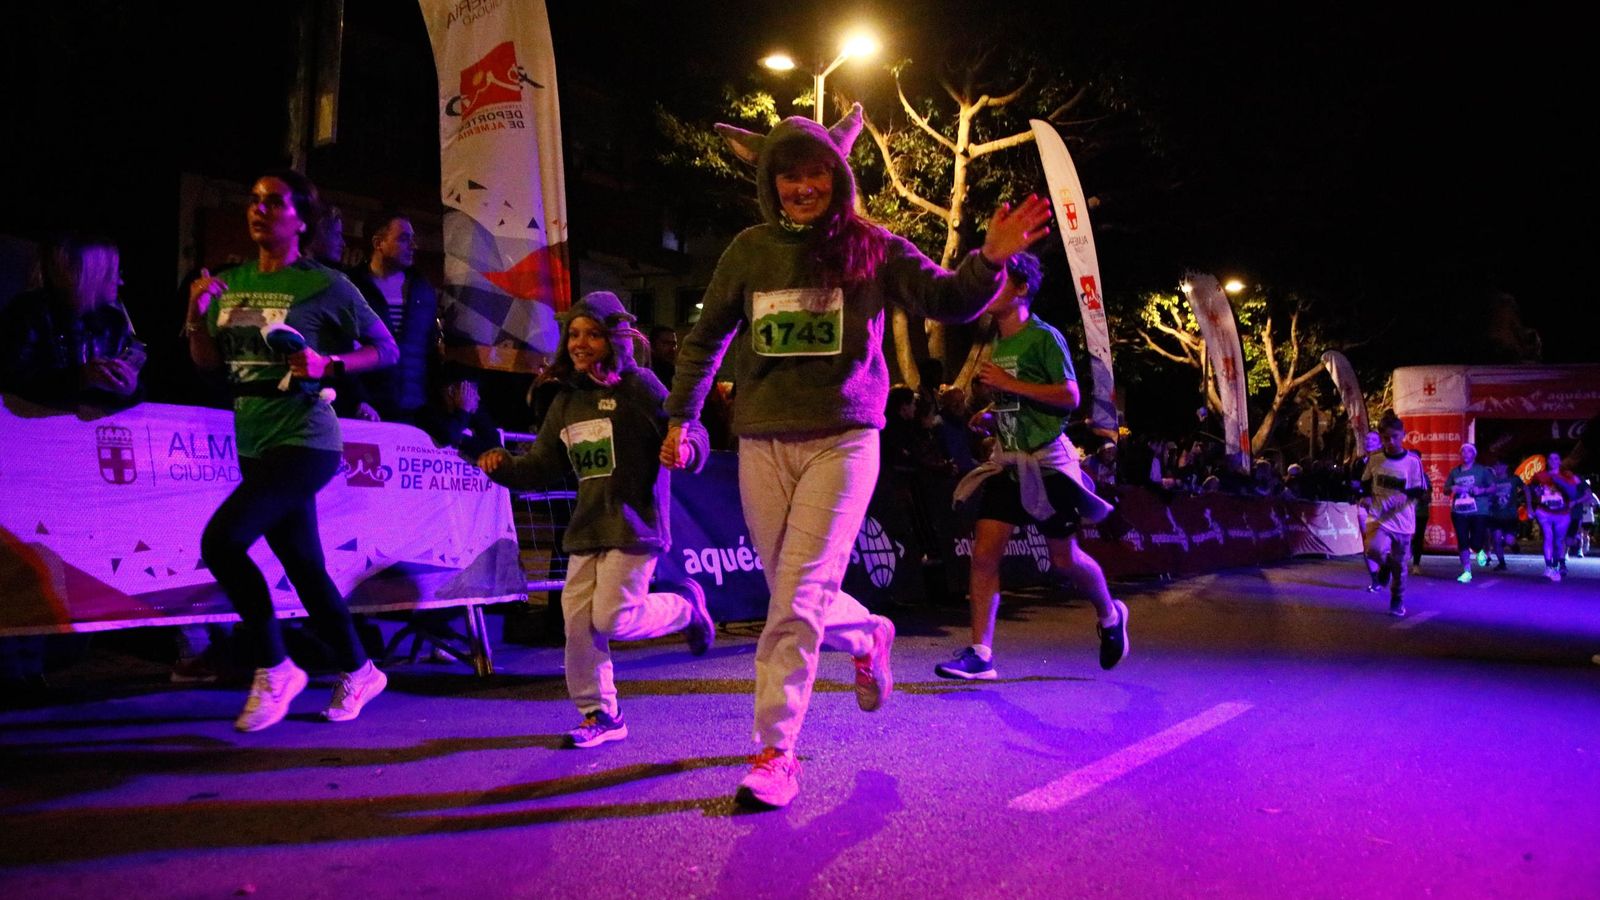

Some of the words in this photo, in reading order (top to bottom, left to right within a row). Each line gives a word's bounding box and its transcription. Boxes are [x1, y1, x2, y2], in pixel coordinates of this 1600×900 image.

[760, 321, 835, 346] 1743
[168, 432, 236, 461] ALM
[169, 463, 242, 483] CIUDAD
[398, 457, 481, 477] DEPORTES
[401, 474, 423, 490] DE
[428, 476, 493, 493] ALMERIA
